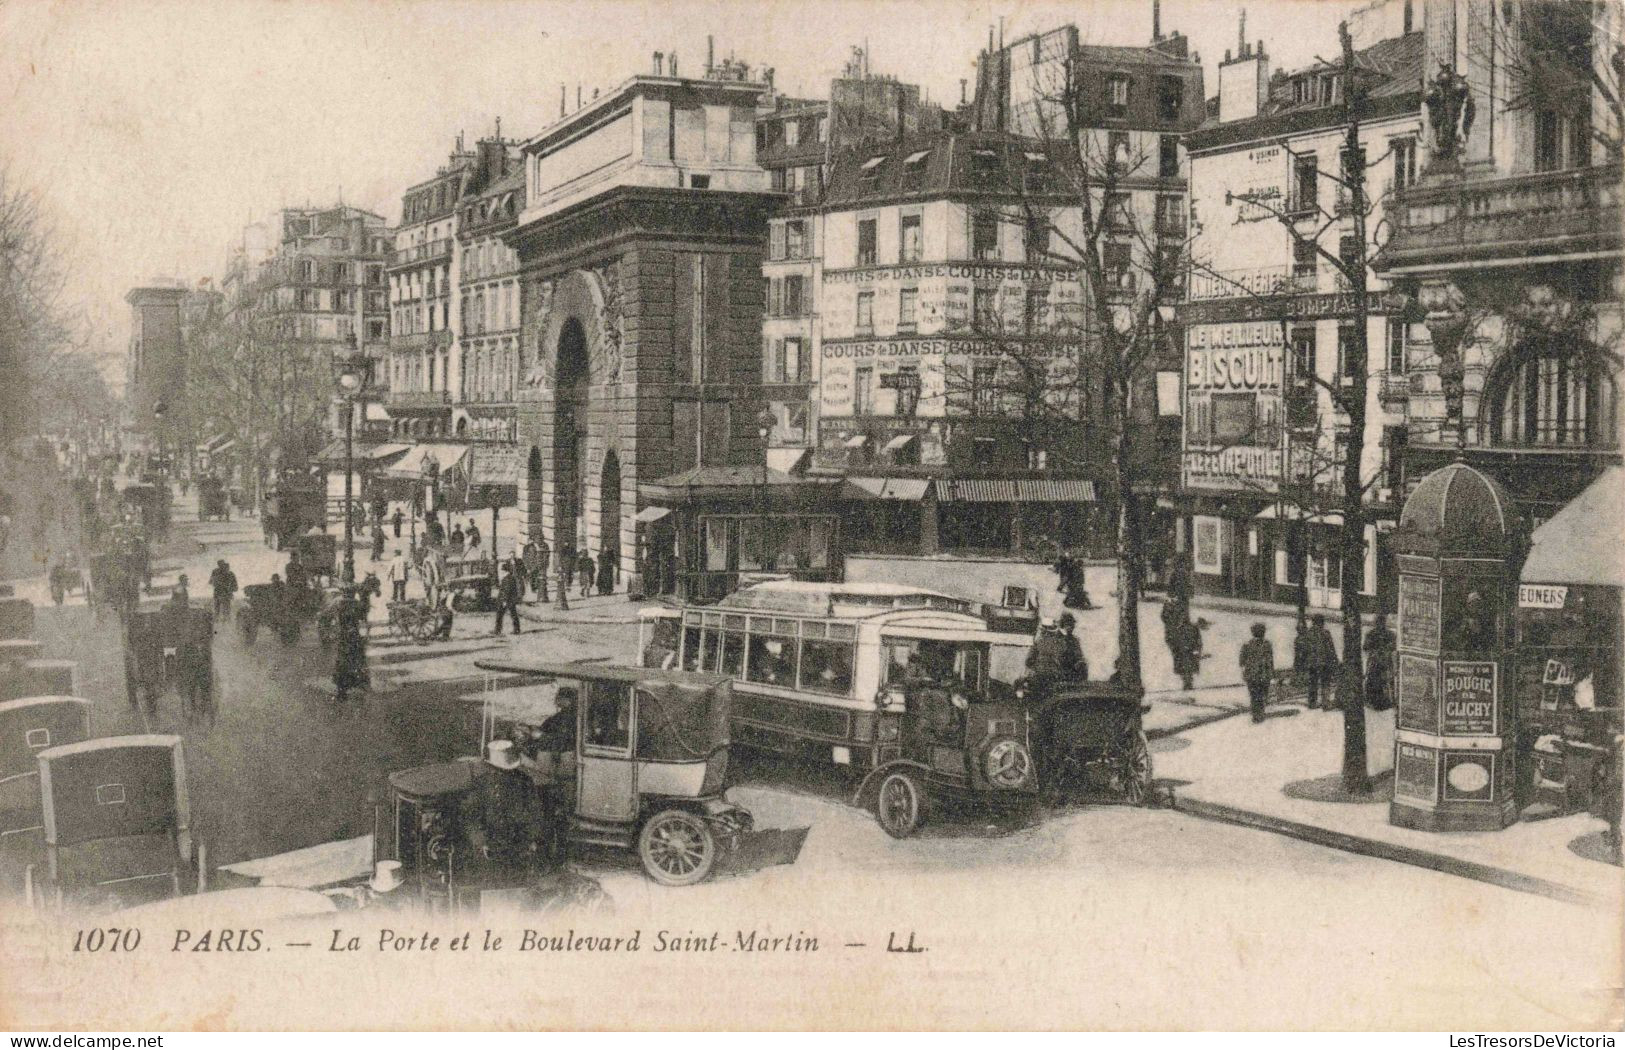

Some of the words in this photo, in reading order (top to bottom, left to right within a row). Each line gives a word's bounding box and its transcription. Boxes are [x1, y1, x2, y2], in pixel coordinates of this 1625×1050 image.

[822, 271, 875, 285] COURS
[892, 266, 945, 280] DANSE
[949, 266, 1005, 280] COURS
[1021, 269, 1079, 283] DANSE
[1189, 327, 1206, 350] LE
[1211, 324, 1284, 349] MEILLEUR
[822, 343, 875, 359] COURS
[888, 341, 942, 356] DANSE
[1188, 349, 1284, 390] BISCUIT
[1446, 676, 1492, 694] BOUGIE
[1446, 701, 1492, 717] CLICHY
